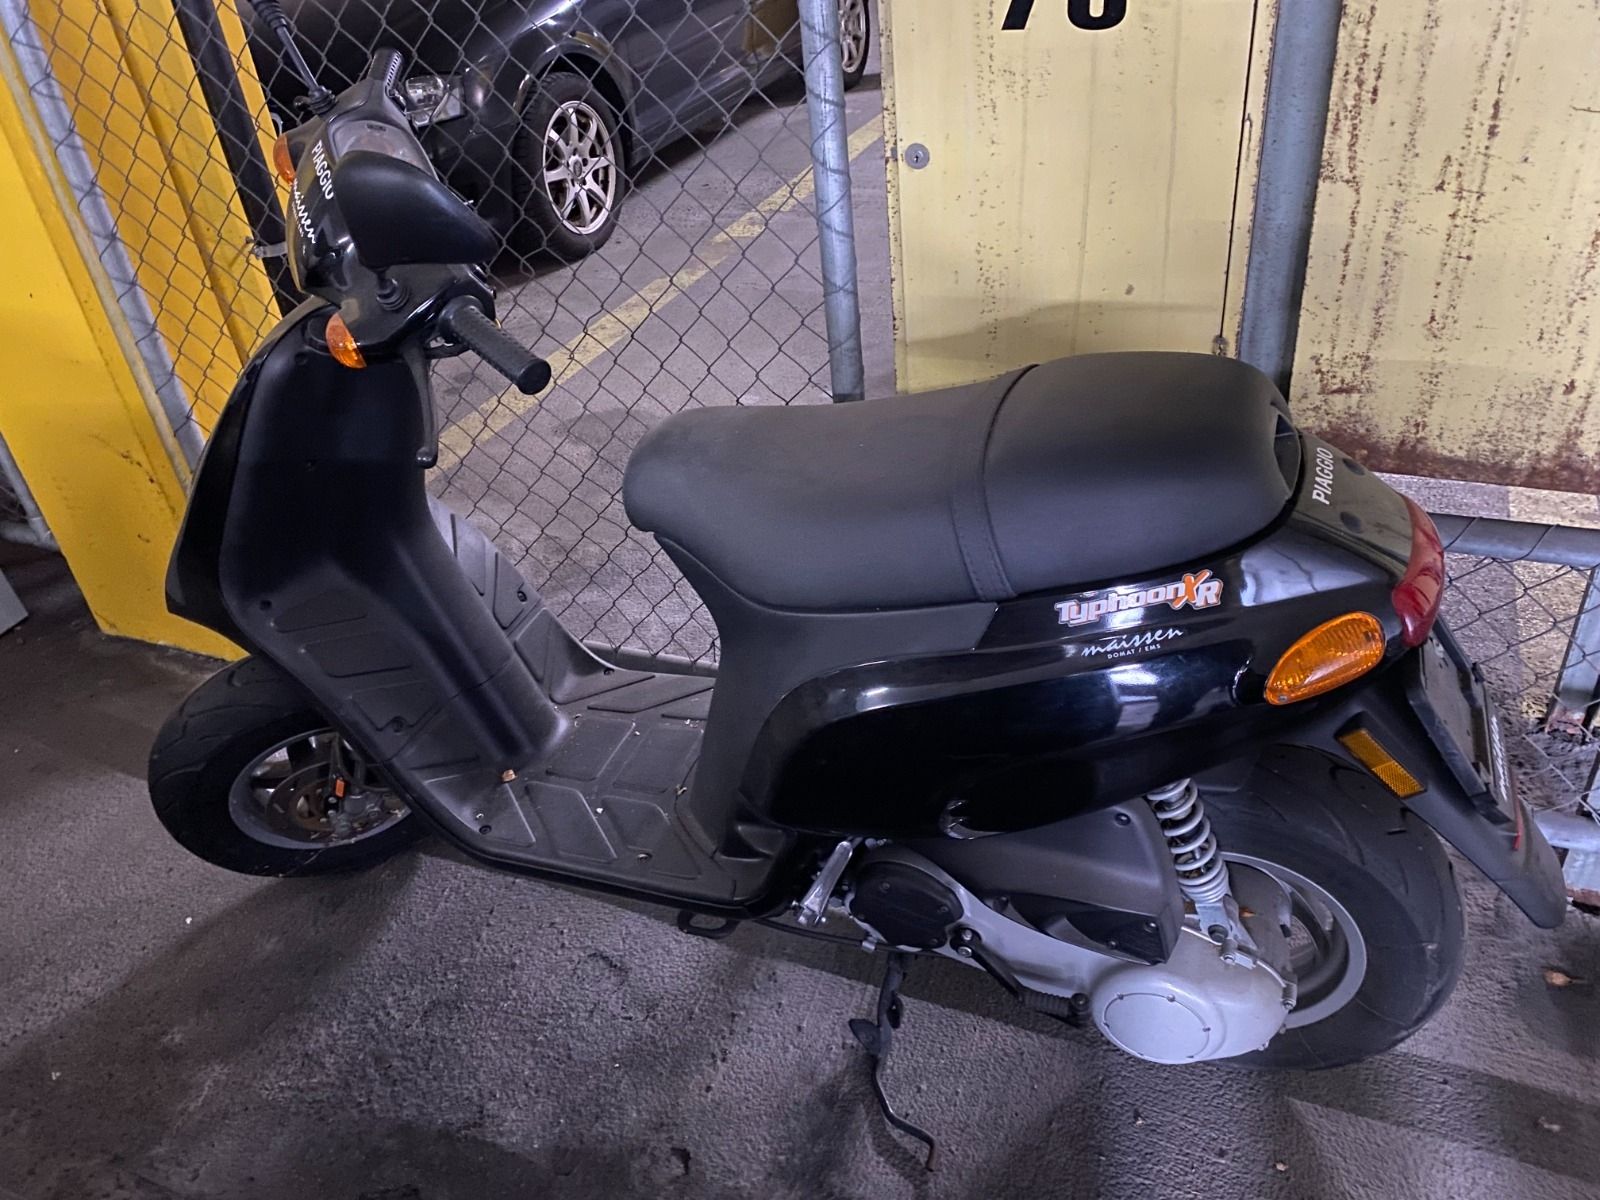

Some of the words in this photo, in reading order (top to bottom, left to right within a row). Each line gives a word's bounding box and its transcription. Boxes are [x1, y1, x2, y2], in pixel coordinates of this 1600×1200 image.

[1312, 447, 1334, 505] PIAGGIO
[1081, 627, 1184, 656] maissen
[1107, 648, 1135, 659] DOMAT
[1144, 643, 1161, 652] EMS
